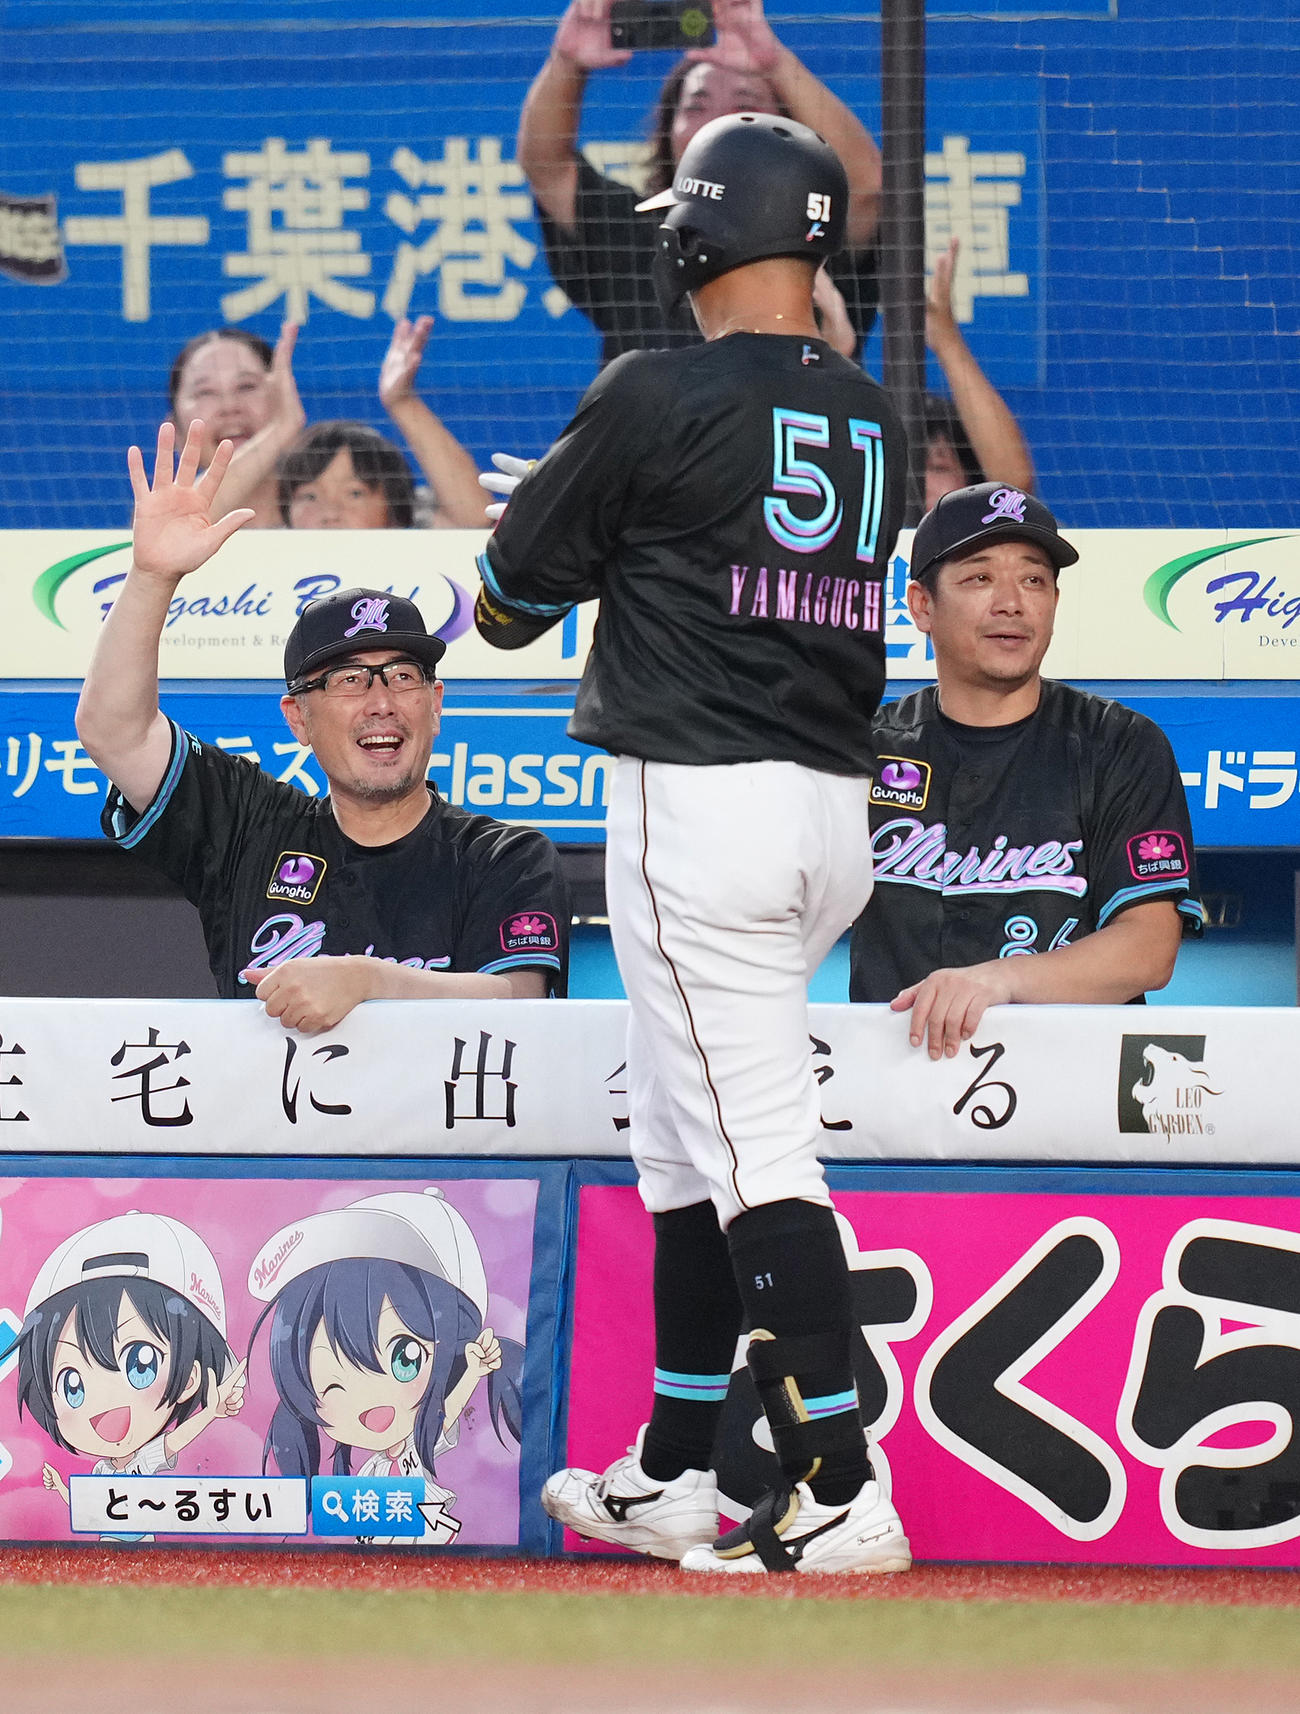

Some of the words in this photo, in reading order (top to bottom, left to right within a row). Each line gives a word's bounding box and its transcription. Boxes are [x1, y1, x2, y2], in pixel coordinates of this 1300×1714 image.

[676, 177, 725, 200] LOTTE
[806, 192, 831, 222] 51
[763, 407, 885, 564] 51
[871, 785, 923, 806] GungHo
[872, 817, 1087, 898] Marines
[1137, 859, 1183, 875] ちば興銀
[269, 881, 312, 900] GungHo
[1175, 1087, 1202, 1109] LEO
[253, 1230, 304, 1290] Marines
[754, 1272, 774, 1290] 51
[190, 1271, 222, 1321] Marines
[351, 1489, 414, 1523] 検索
